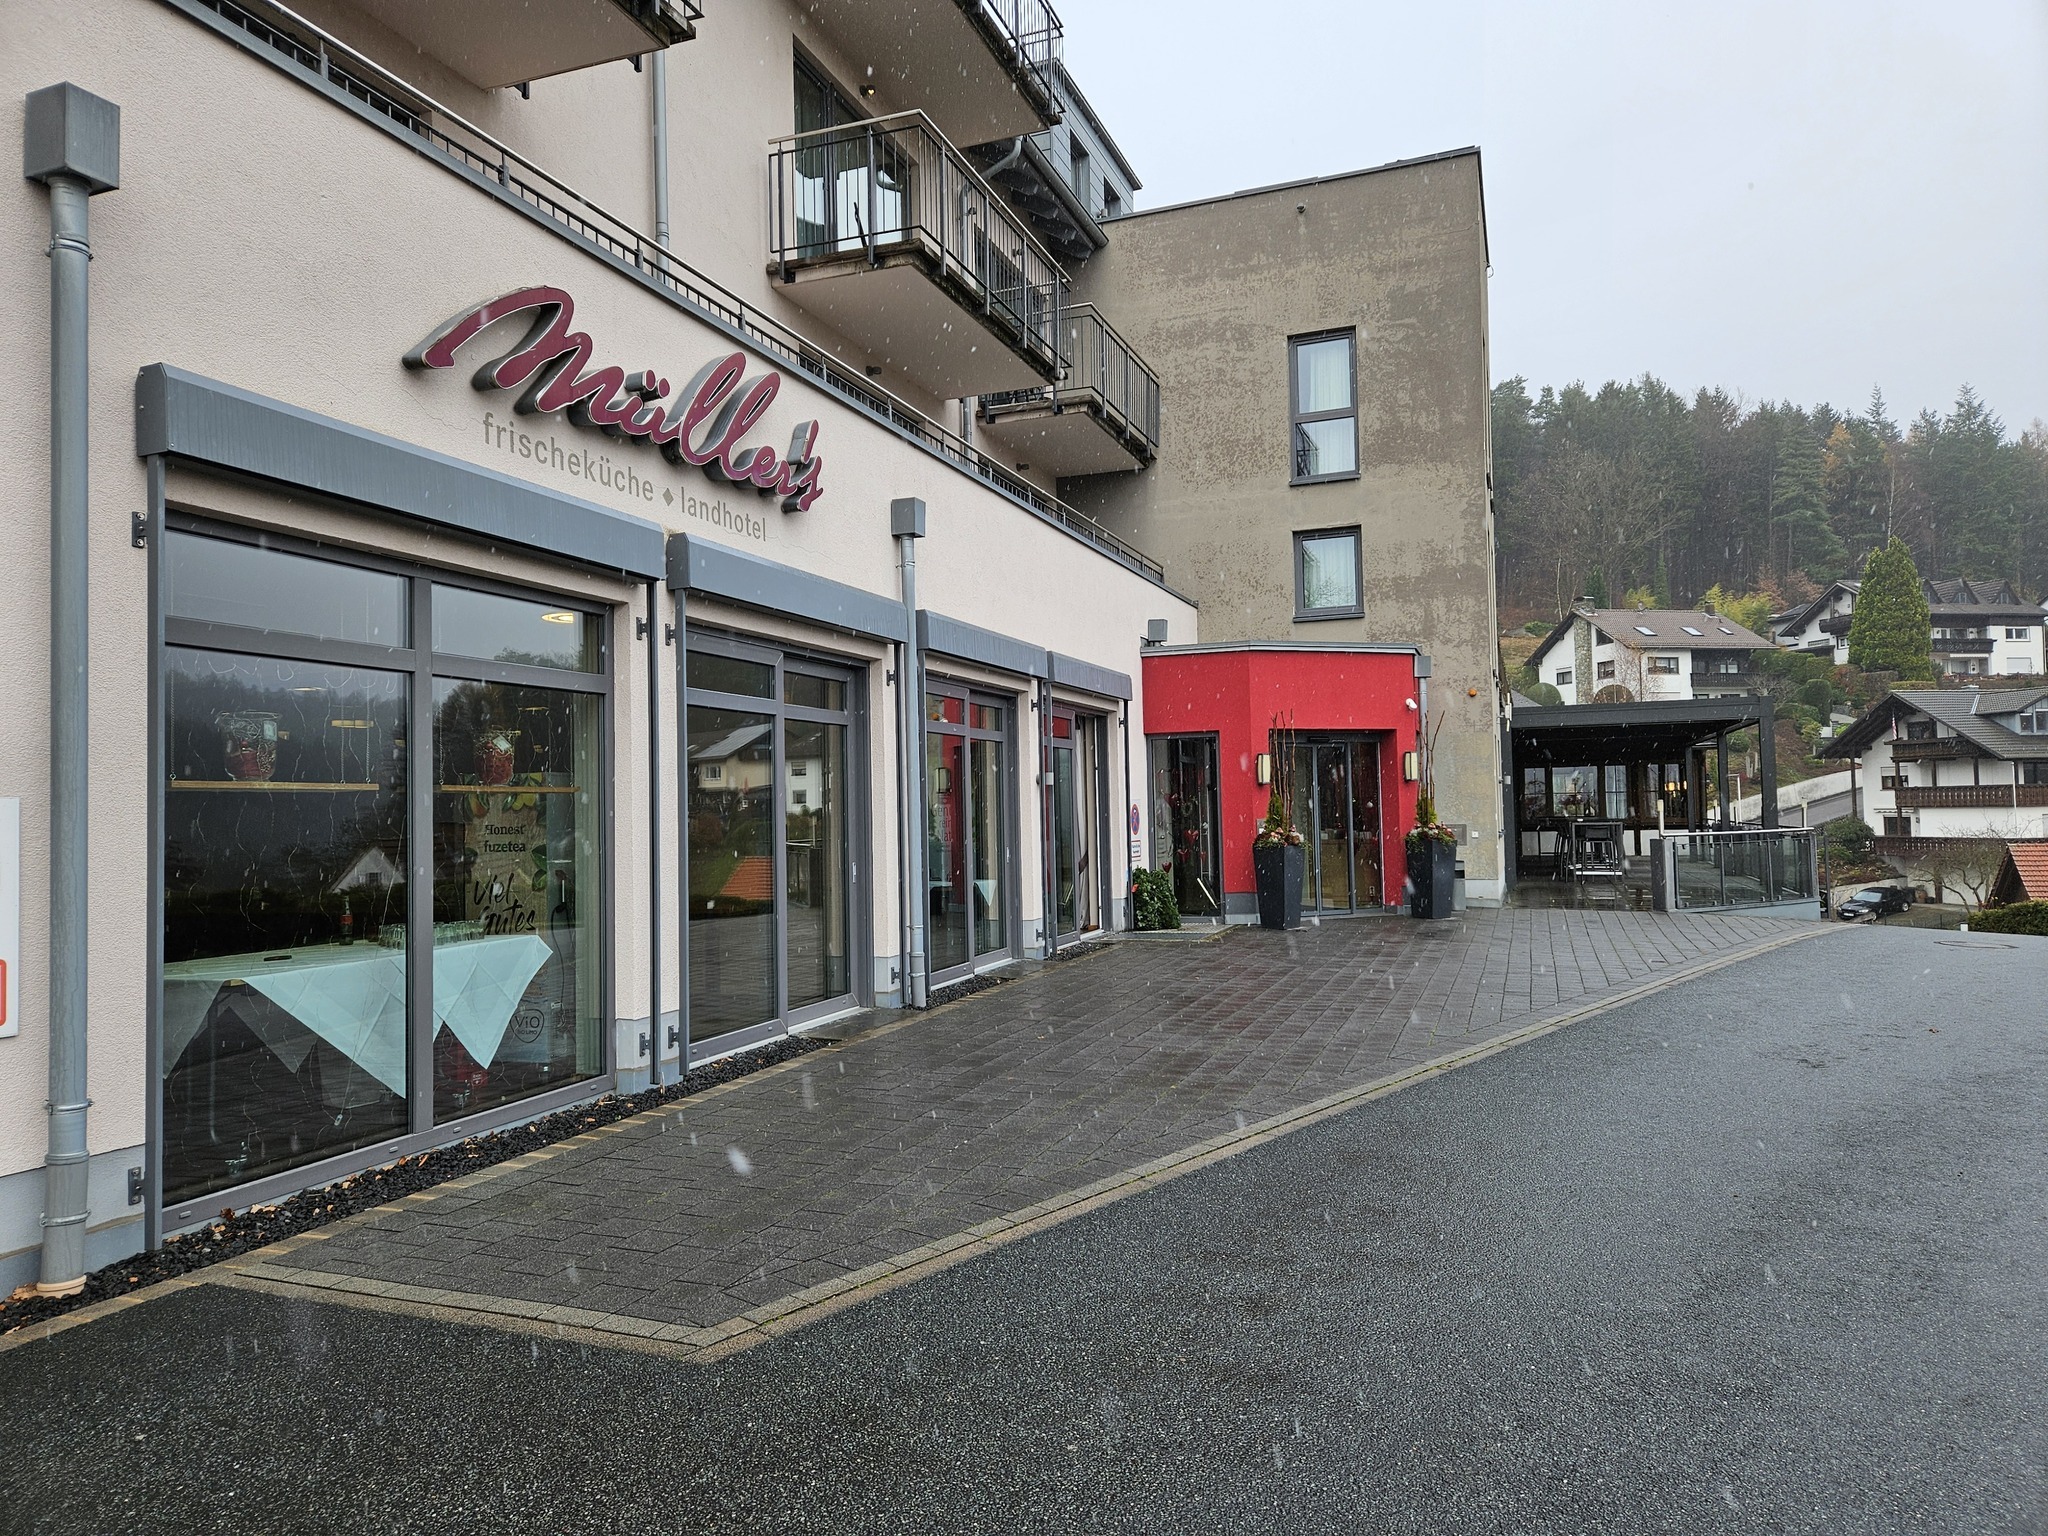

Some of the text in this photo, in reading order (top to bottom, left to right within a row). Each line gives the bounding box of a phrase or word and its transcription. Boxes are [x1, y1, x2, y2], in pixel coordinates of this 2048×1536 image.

[482, 411, 767, 543] frischeküche landhotel
[484, 840, 526, 853] fuzetea
[474, 873, 515, 906] Viel
[514, 1015, 540, 1028] ViO
